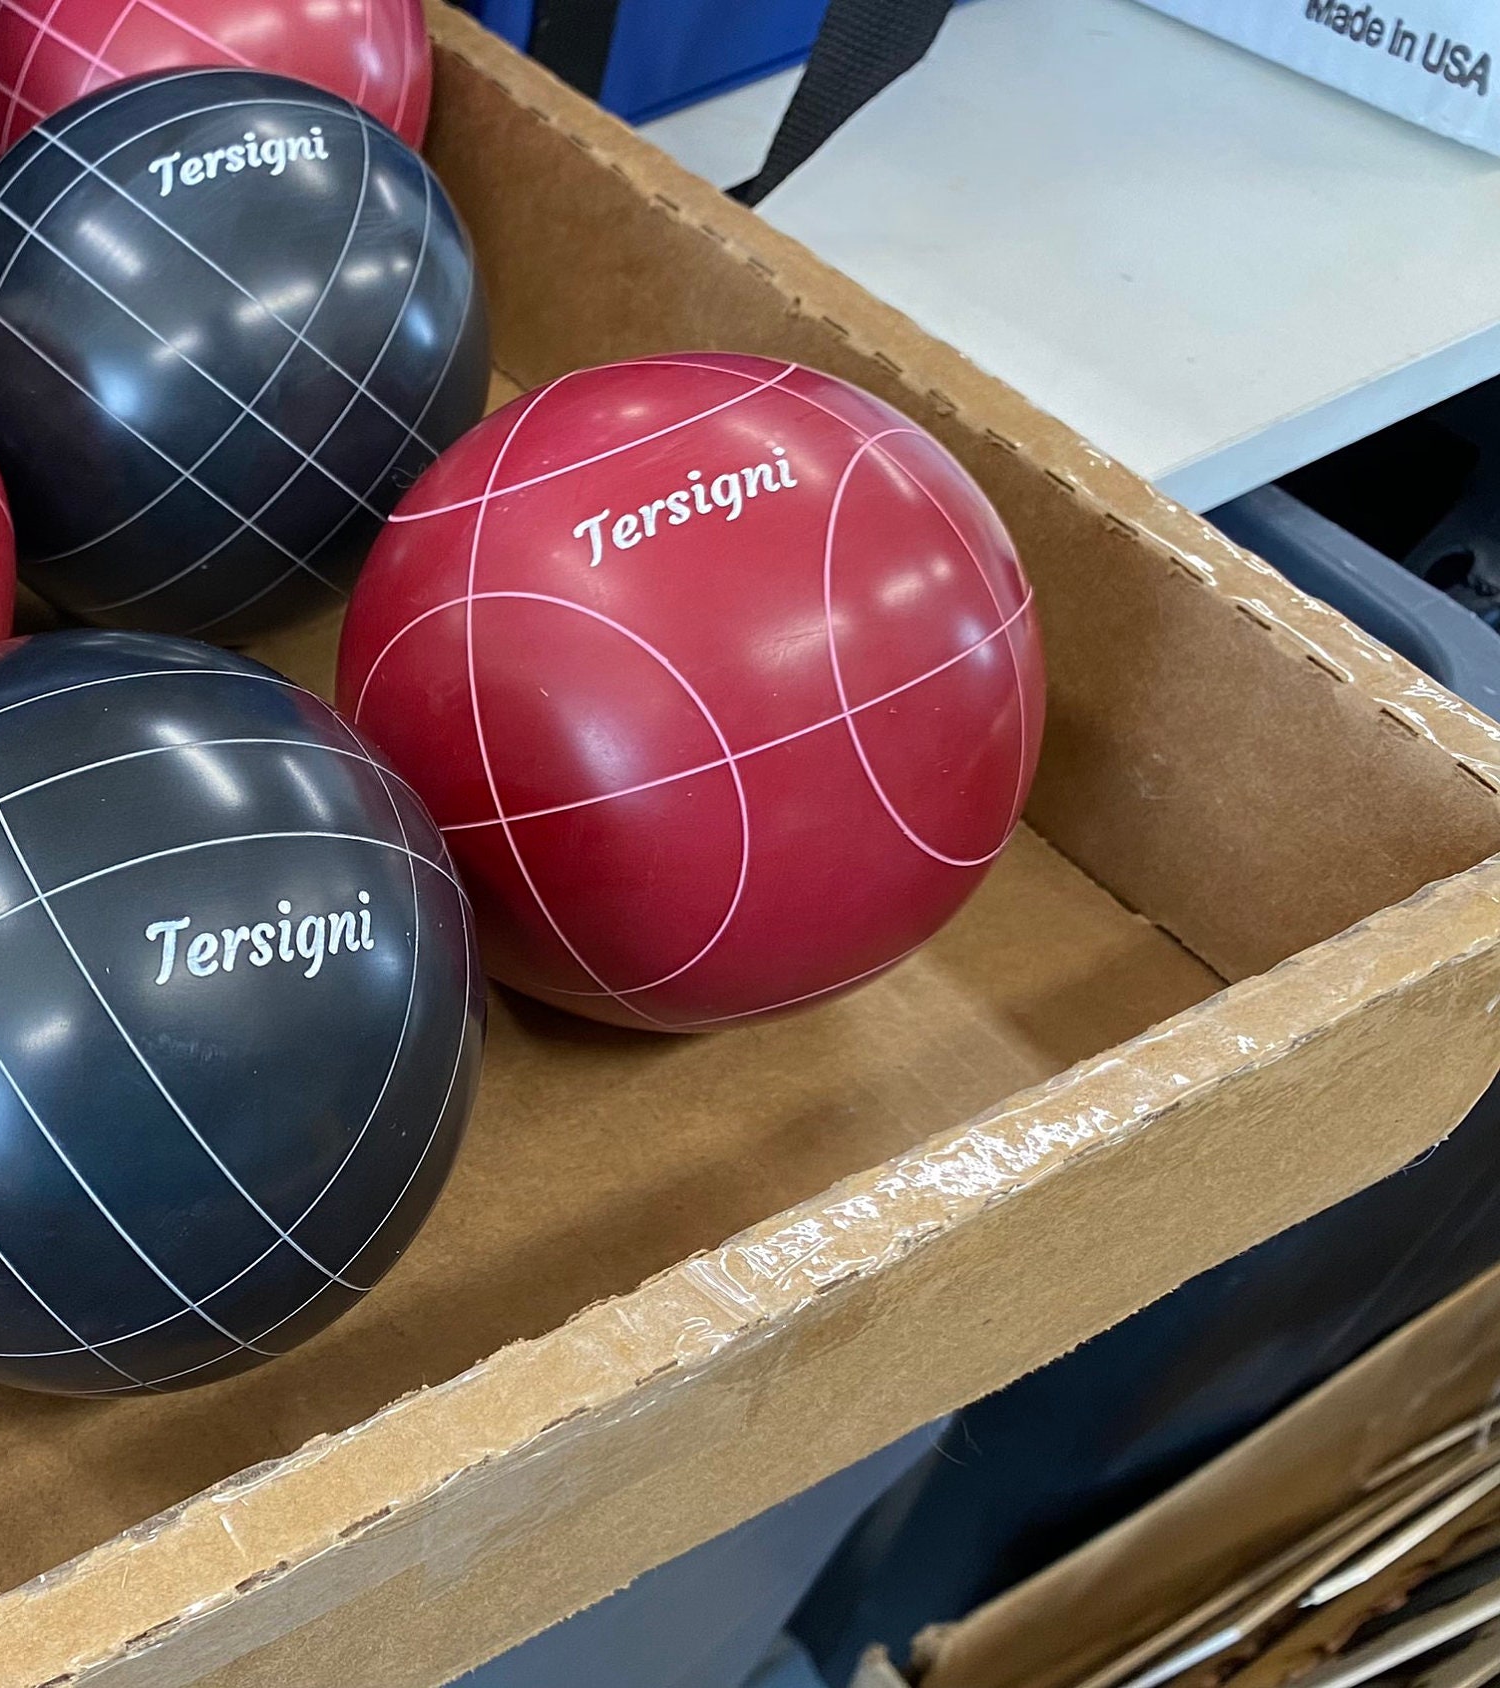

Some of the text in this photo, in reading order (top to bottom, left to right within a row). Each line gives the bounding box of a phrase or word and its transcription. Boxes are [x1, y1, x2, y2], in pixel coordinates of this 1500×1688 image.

[1305, 0, 1386, 47] Made
[1422, 33, 1491, 96] USA
[148, 126, 329, 197] Tersigni
[572, 446, 796, 568] Tersigni
[145, 890, 375, 986] Tersigni
